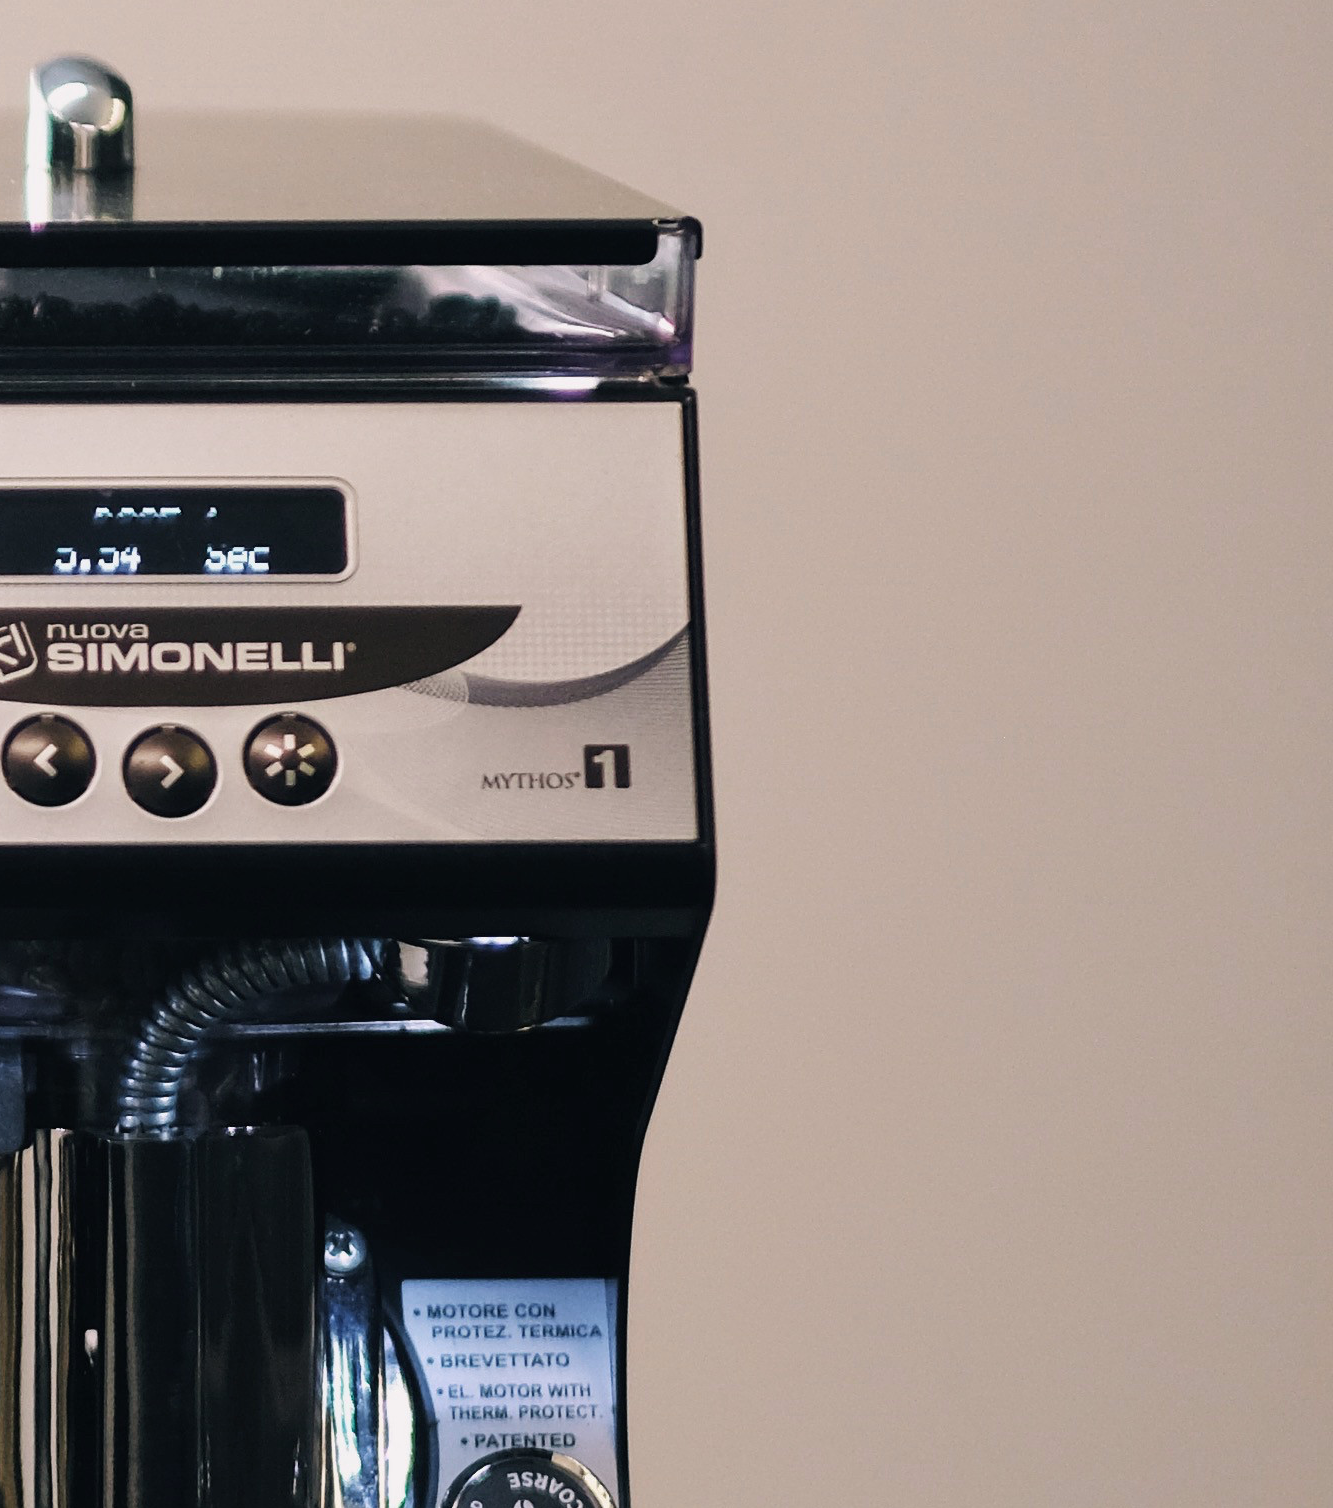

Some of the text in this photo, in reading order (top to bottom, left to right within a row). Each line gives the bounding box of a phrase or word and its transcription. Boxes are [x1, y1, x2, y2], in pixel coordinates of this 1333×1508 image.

[46, 623, 149, 639] nuova
[46, 642, 345, 672] SIMONELLI
[482, 772, 575, 789] MYTHOS
[427, 1303, 556, 1319] MOTORE CON
[432, 1324, 603, 1339] PROTEZ. TERMICA
[441, 1353, 570, 1368] BREVETTATO
[479, 1384, 543, 1398] MOTOR
[548, 1383, 591, 1397] WITH
[450, 1404, 603, 1420] THERM. PROTECT.
[474, 1433, 576, 1448] PATENTED
